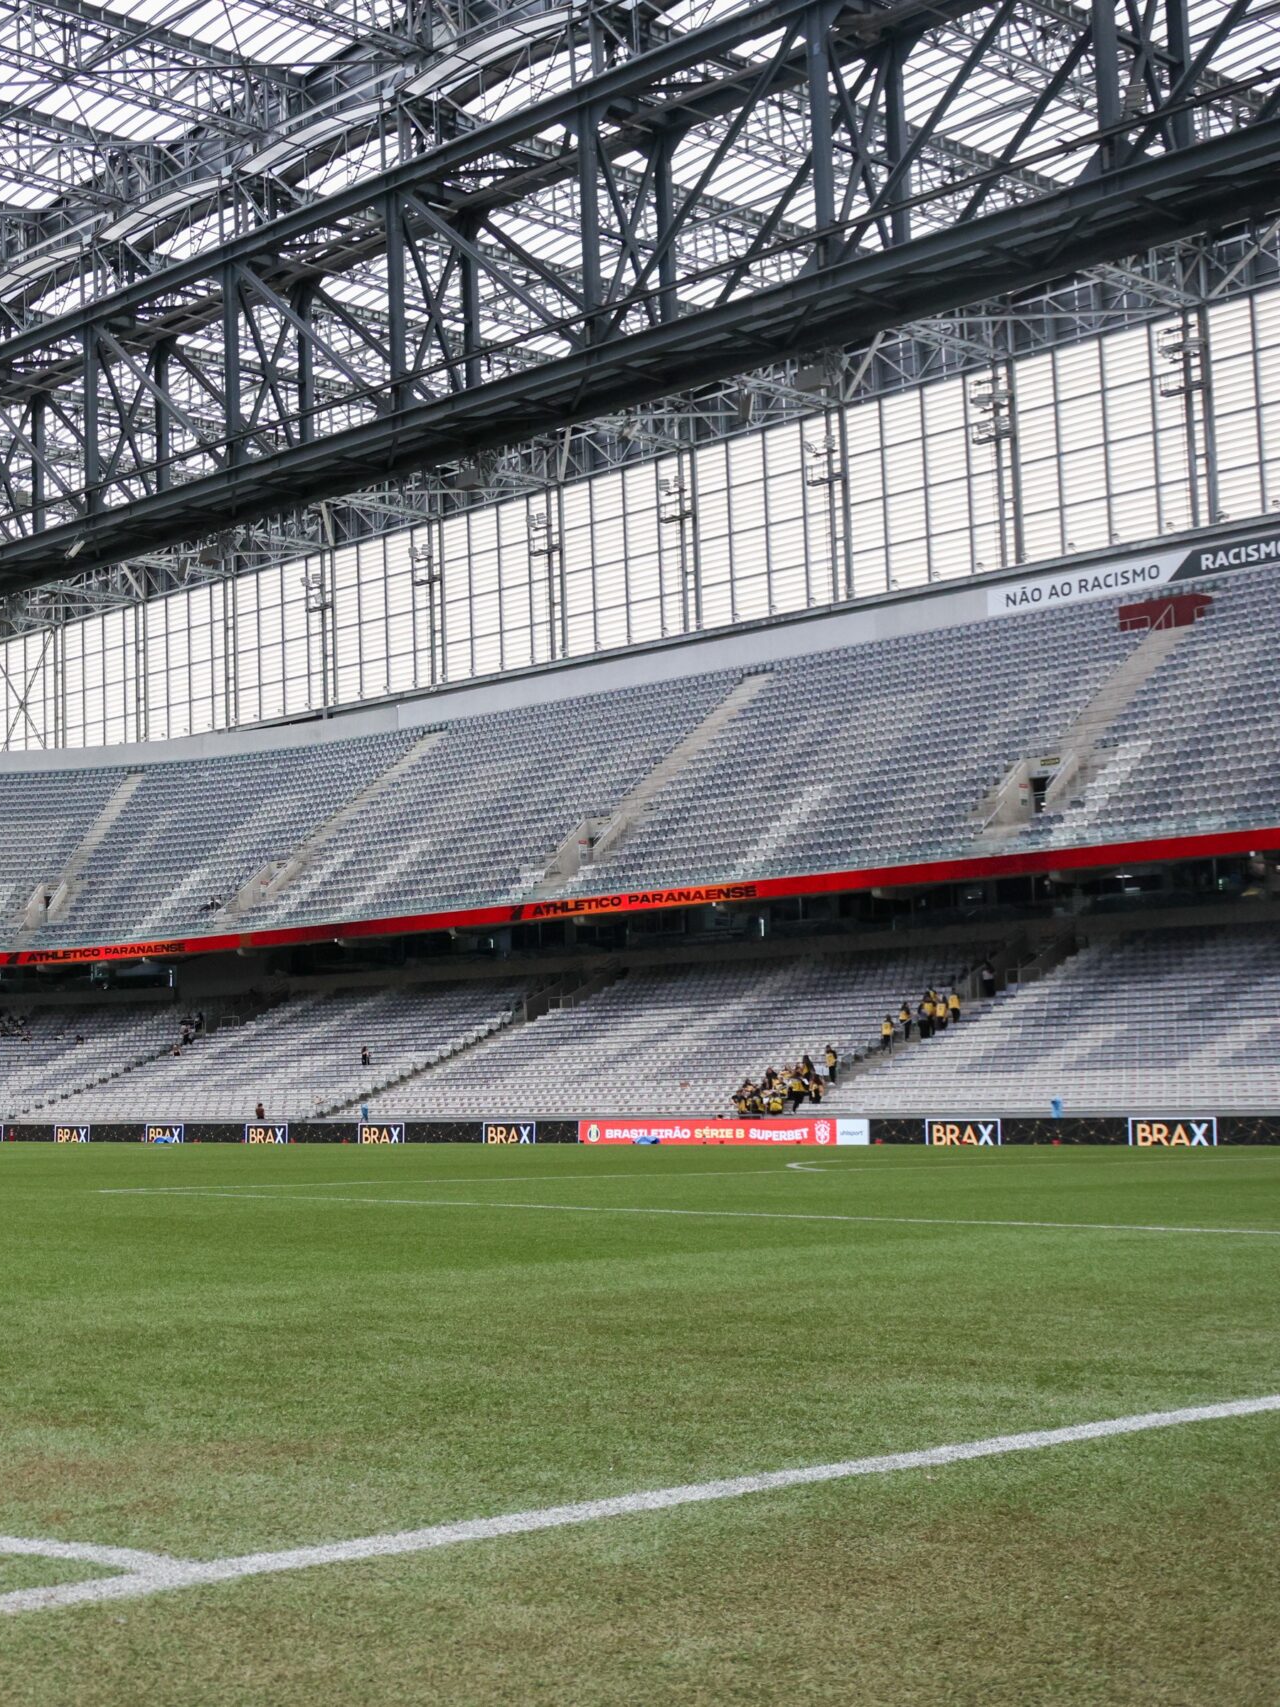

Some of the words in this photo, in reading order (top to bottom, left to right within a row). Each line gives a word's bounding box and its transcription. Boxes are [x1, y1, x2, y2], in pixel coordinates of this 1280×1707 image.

[1201, 540, 1280, 570] RACISM
[1005, 586, 1042, 607] NÃO
[1048, 582, 1071, 599] AO
[1078, 564, 1160, 593] RACISMO
[532, 897, 622, 917] ATHLETICO
[628, 885, 757, 905] PARANAENSE
[27, 949, 100, 963] ATHLETICO
[104, 943, 186, 955] PARANAENSE
[57, 1128, 86, 1143] BRAX
[249, 1128, 284, 1143] BRAX
[362, 1127, 400, 1144] BRAX
[487, 1126, 530, 1144] BRAX
[605, 1126, 691, 1139] BRASILEIRÃO
[694, 1126, 735, 1139] SÉRIE
[736, 1128, 745, 1139] B
[749, 1128, 809, 1141] SUPERBET
[932, 1124, 995, 1146] BRAX
[1136, 1123, 1209, 1146] BRAX
